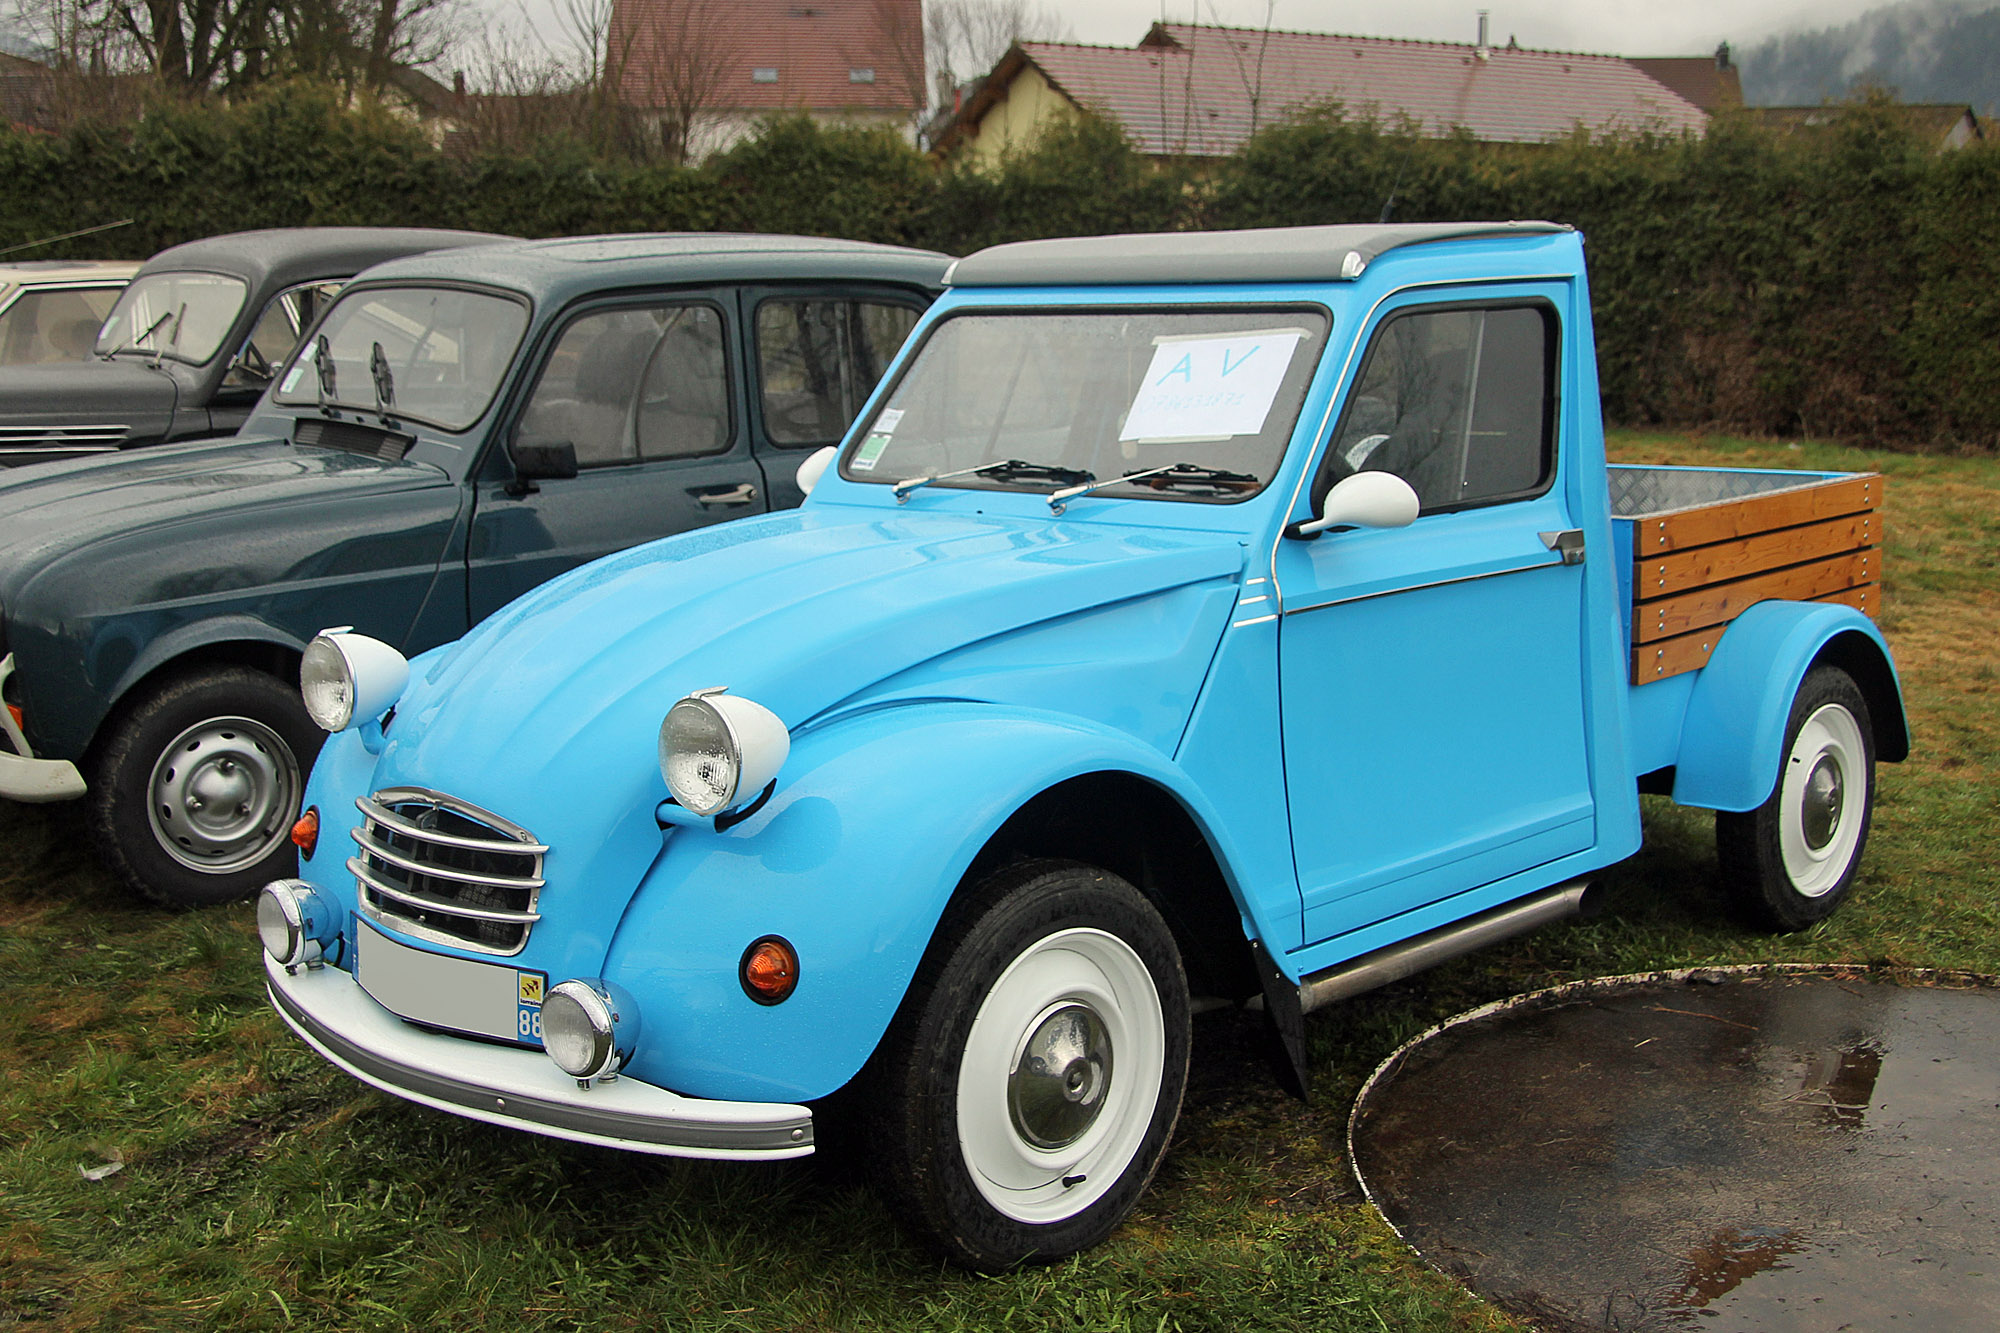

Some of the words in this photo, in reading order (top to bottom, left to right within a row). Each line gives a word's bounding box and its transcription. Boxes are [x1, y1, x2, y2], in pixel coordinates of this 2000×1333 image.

[1156, 352, 1191, 386] A
[1221, 345, 1261, 377] V
[519, 1009, 541, 1038] 88
